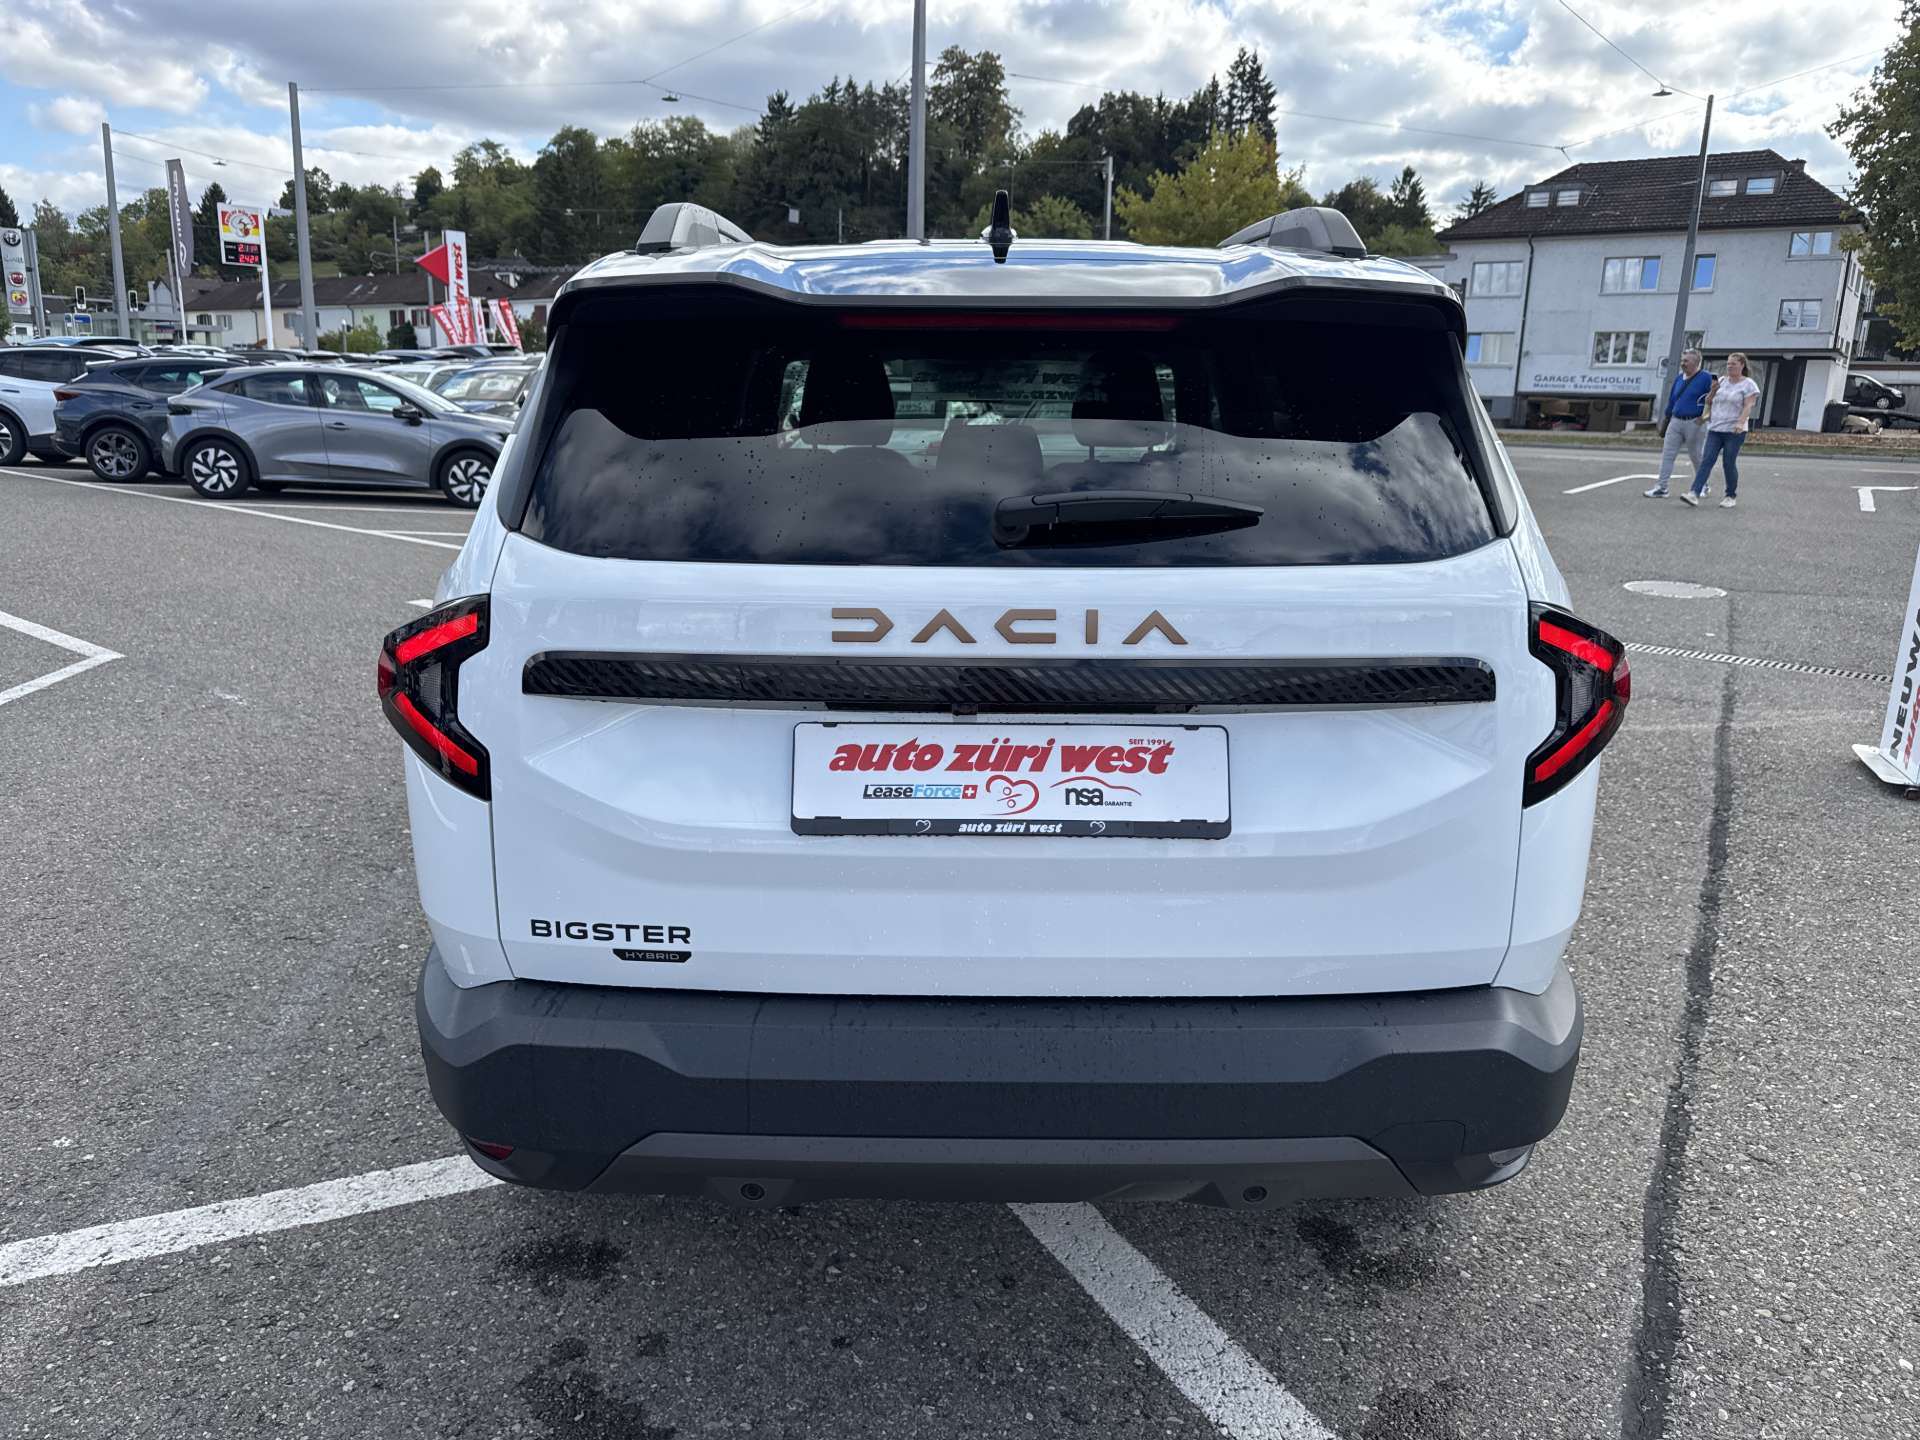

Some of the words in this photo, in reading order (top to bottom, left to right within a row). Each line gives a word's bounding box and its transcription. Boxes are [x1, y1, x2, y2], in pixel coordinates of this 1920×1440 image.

[453, 242, 464, 280] west
[1580, 375, 1643, 384] TACHOLINE
[832, 608, 1189, 645] DACIA
[1128, 738, 1145, 746] SEIT
[1146, 739, 1168, 747] 1991
[828, 738, 944, 772] auto
[945, 737, 1055, 772] züri
[1060, 740, 1175, 775] west
[862, 783, 962, 800] LeaseForce
[1065, 787, 1104, 807] nsa
[1104, 800, 1133, 808] GARANTIE
[958, 821, 993, 833] auto
[994, 821, 1027, 833] züri
[1029, 822, 1063, 834] west
[530, 919, 691, 945] BIGSTER
[624, 952, 681, 960] HYBRID
